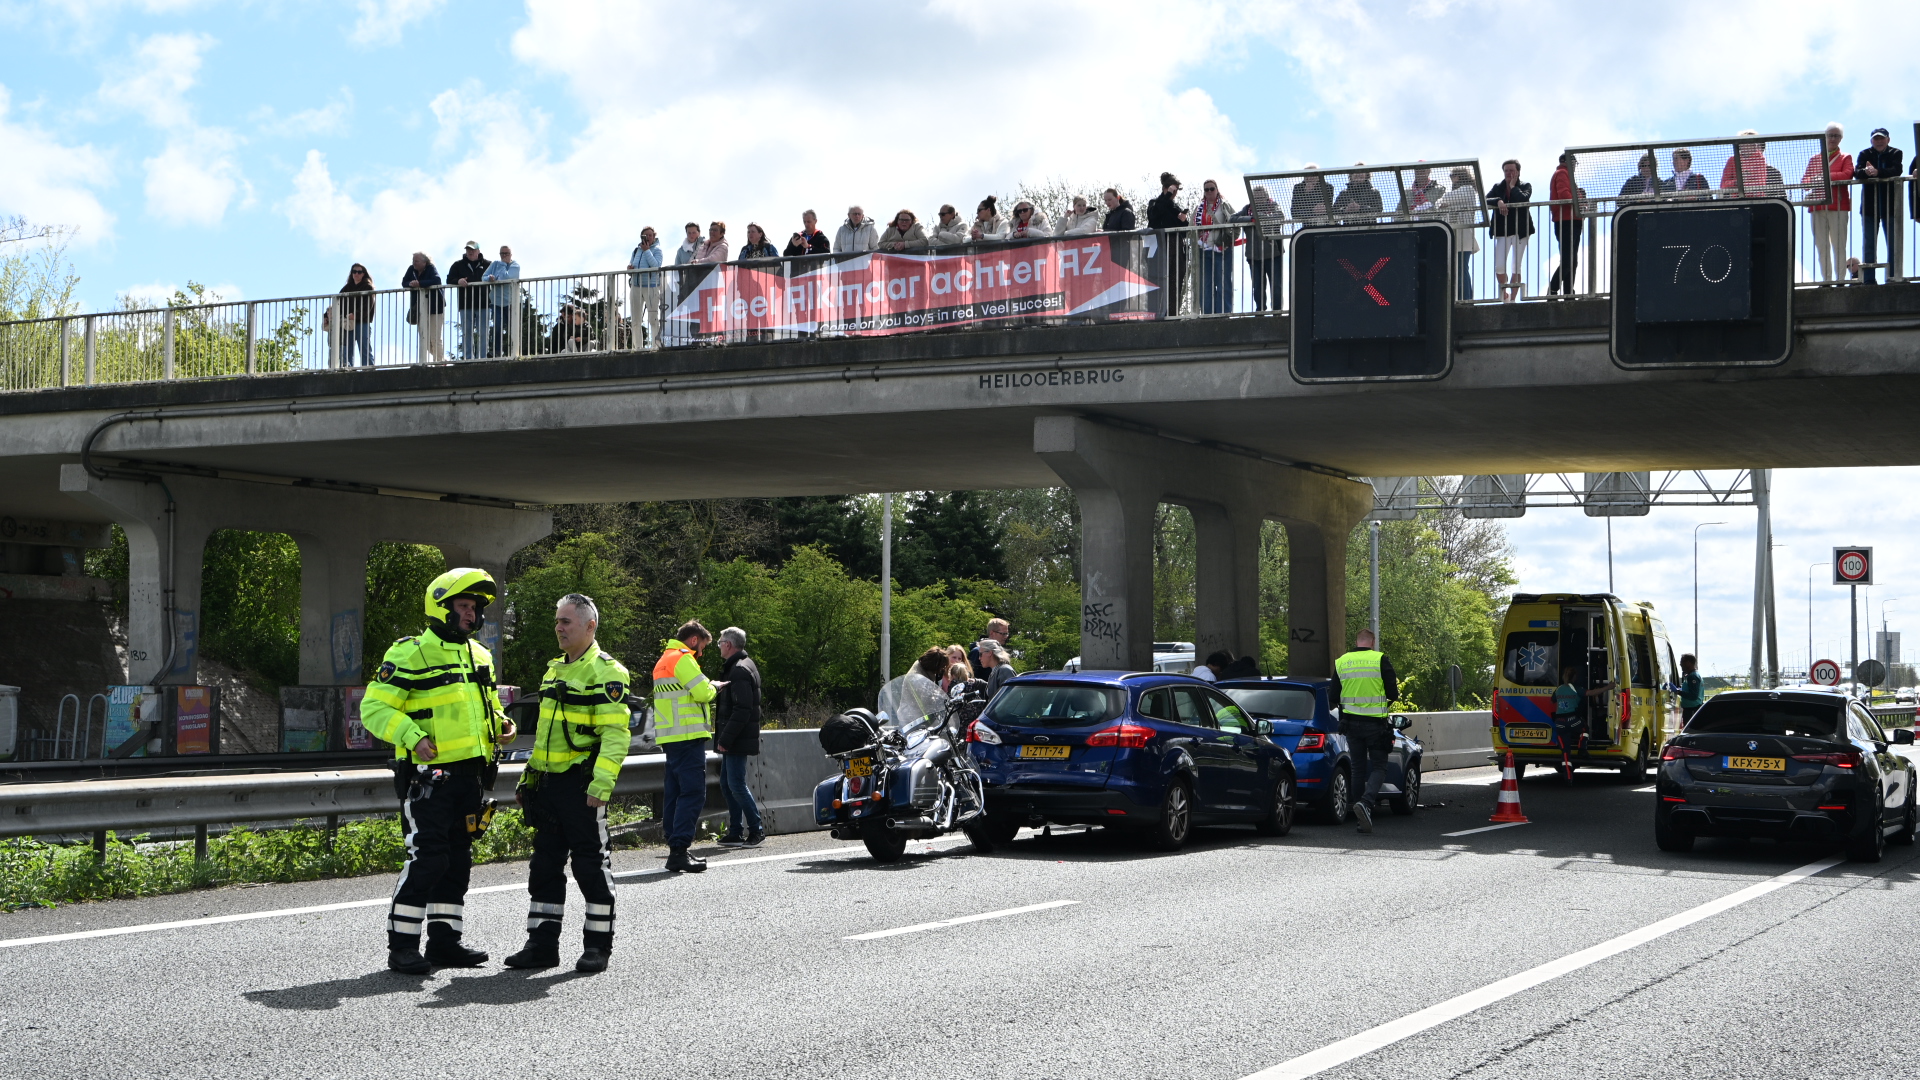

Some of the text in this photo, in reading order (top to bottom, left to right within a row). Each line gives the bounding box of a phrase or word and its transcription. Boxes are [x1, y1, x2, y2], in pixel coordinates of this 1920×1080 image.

[1662, 244, 1731, 283] 70
[707, 246, 1103, 322] Heel Alkmaar achter AZ
[860, 320, 875, 330] on
[879, 318, 901, 330] you
[905, 313, 934, 326] boys
[937, 310, 949, 321] in
[952, 304, 978, 319] red.
[981, 302, 1009, 316] Veel
[1012, 294, 1062, 312] succes!
[980, 369, 1125, 389] HEILOOERBRUG
[1843, 561, 1862, 571] 100
[1084, 602, 1113, 616] AFC
[1815, 669, 1835, 679] 100
[1500, 687, 1553, 695] AMBULANCE
[1026, 747, 1064, 756] 1-ZTT-74
[853, 759, 865, 768] MN
[1732, 758, 1781, 769] KFX-75-X
[846, 767, 870, 777] RL-56
